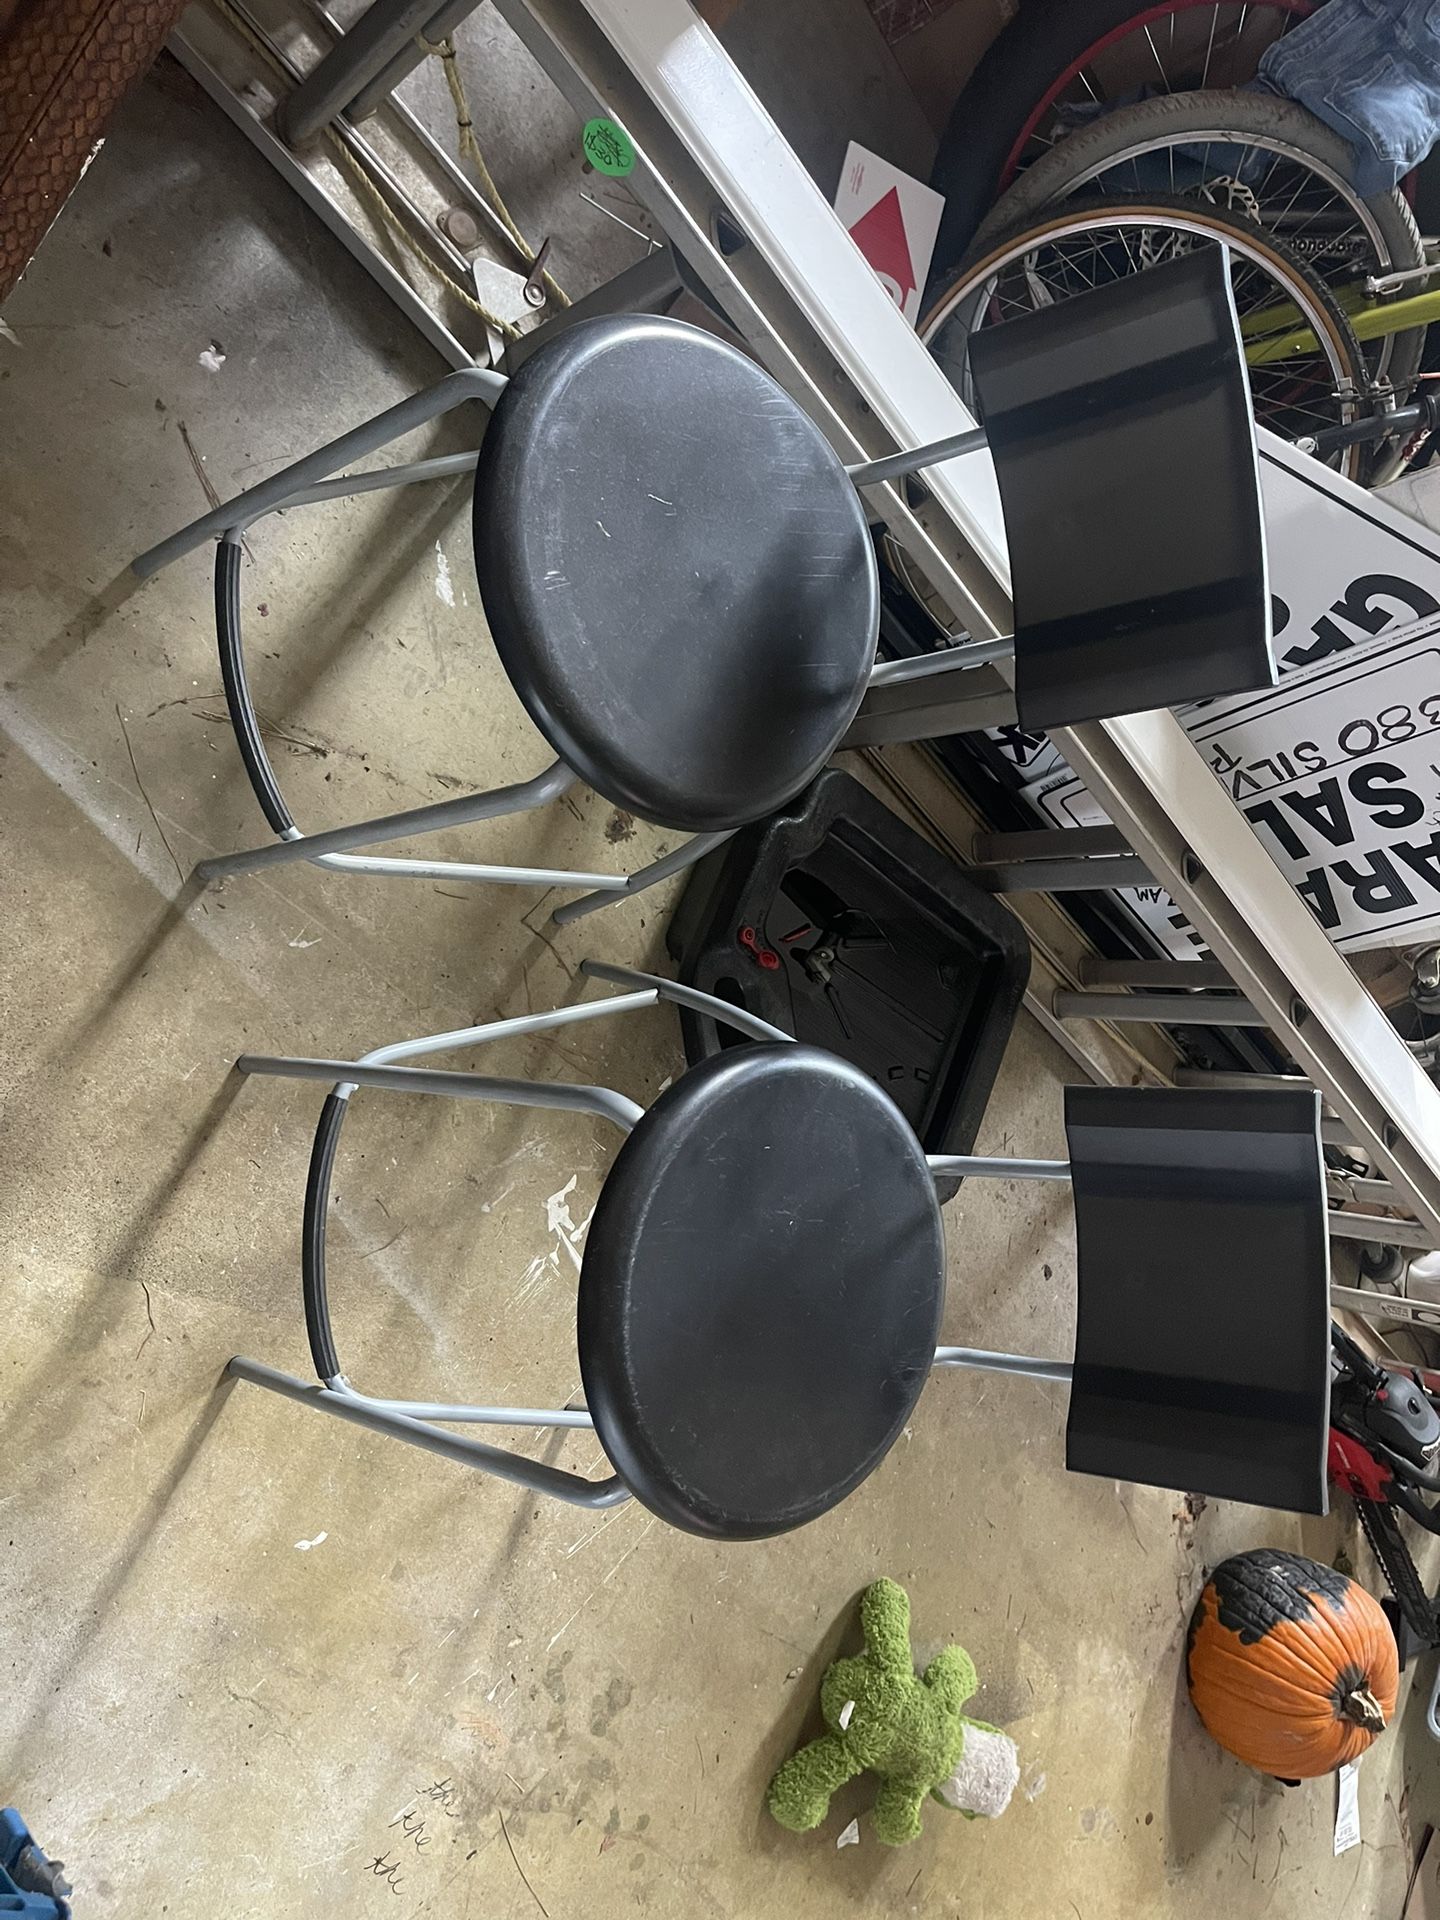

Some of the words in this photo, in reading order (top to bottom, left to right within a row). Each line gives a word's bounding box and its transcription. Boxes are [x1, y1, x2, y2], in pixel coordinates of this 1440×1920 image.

[1277, 574, 1440, 675] GA
[1221, 741, 1328, 799] SILV
[1243, 761, 1426, 861] SAL
